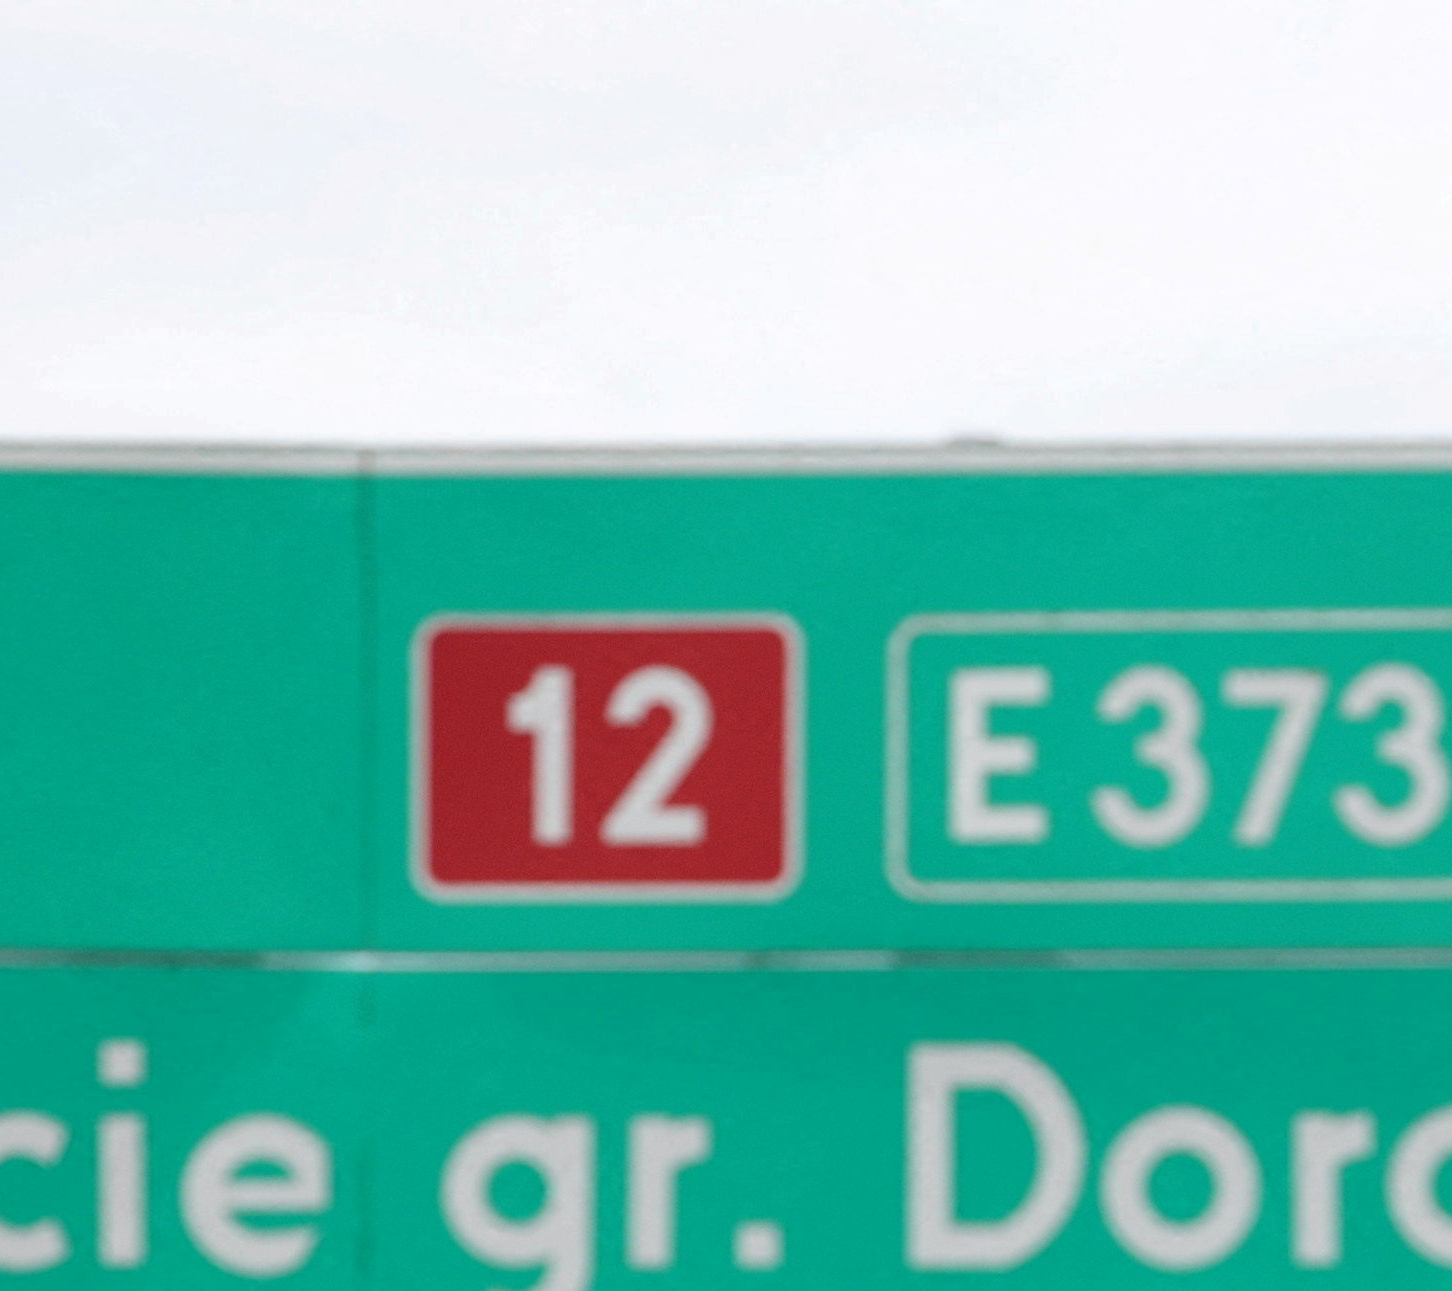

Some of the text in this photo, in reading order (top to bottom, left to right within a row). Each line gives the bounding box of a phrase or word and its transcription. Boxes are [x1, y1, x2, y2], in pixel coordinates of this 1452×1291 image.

[508, 666, 711, 845] 12
[949, 664, 1450, 846] E 373
